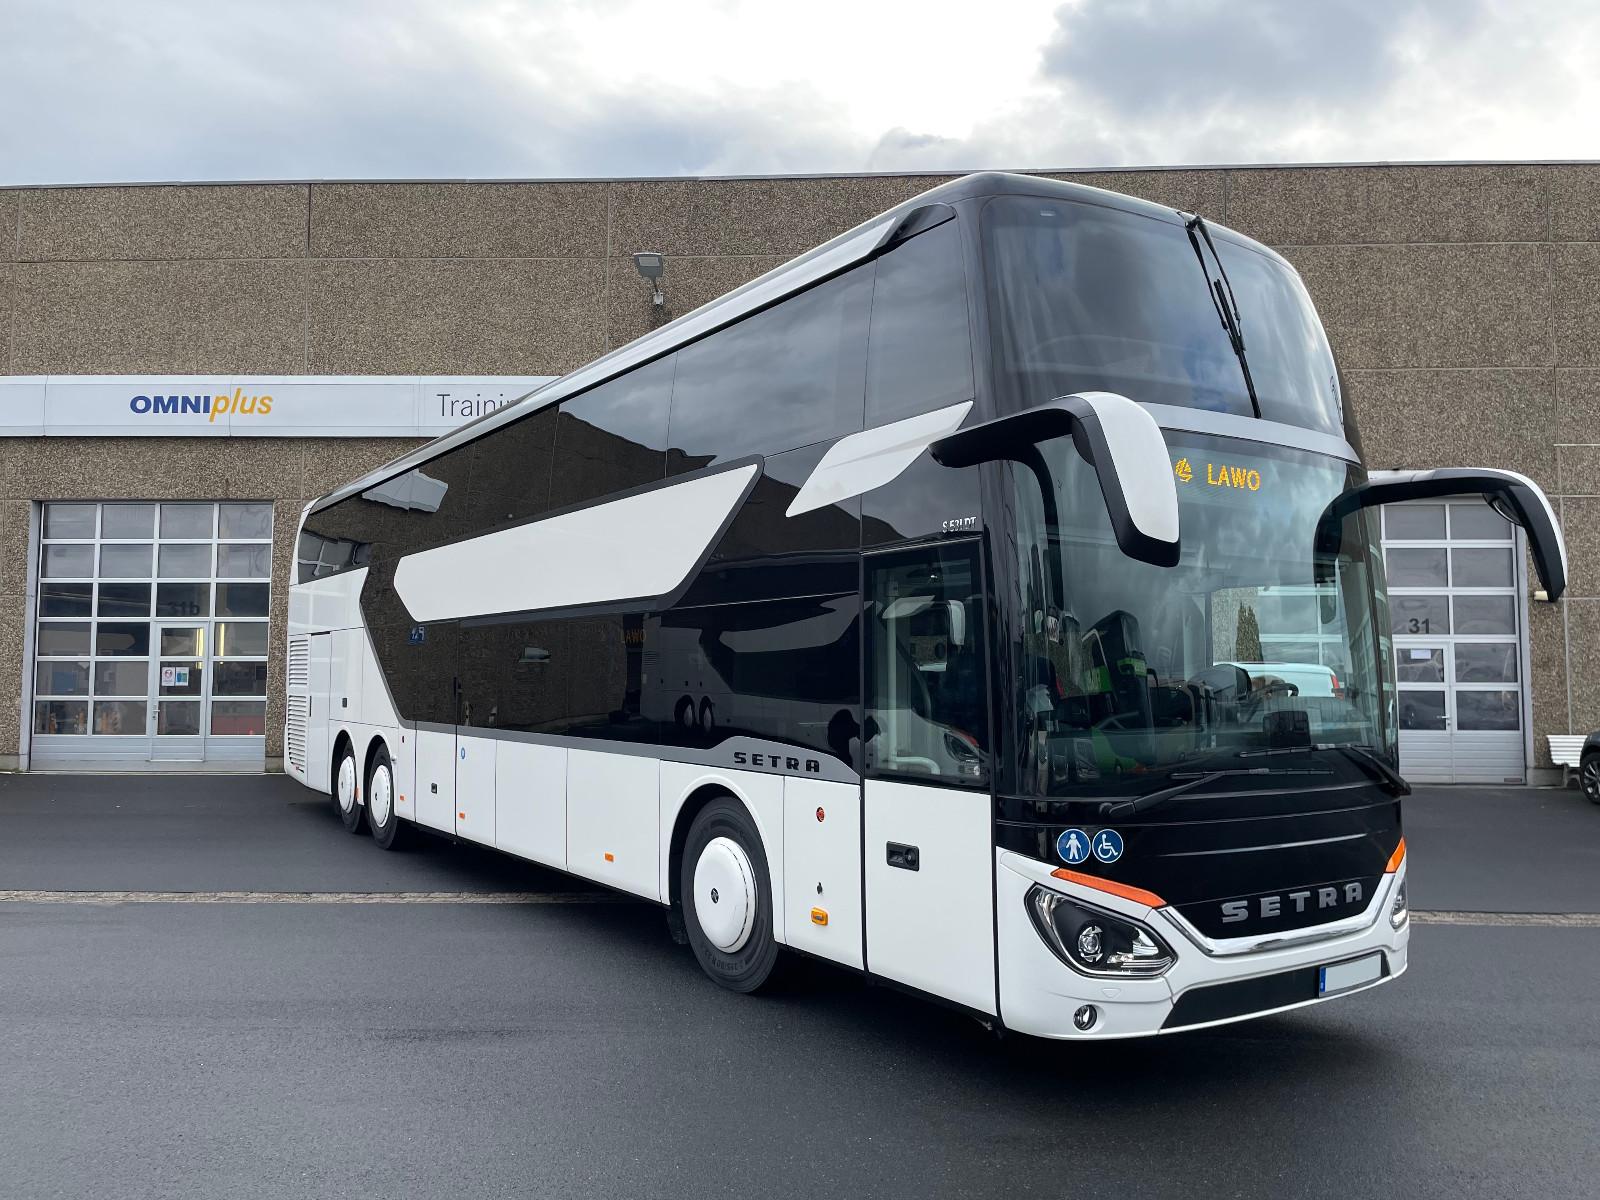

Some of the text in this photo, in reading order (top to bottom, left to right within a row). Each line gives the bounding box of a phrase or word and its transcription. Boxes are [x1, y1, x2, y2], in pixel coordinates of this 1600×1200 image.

[130, 387, 273, 422] OMNIplus
[436, 393, 513, 417] Traini
[1207, 463, 1260, 491] LAWO
[1408, 617, 1430, 634] 31
[733, 751, 820, 773] SETRA
[1220, 882, 1363, 924] SETRA
